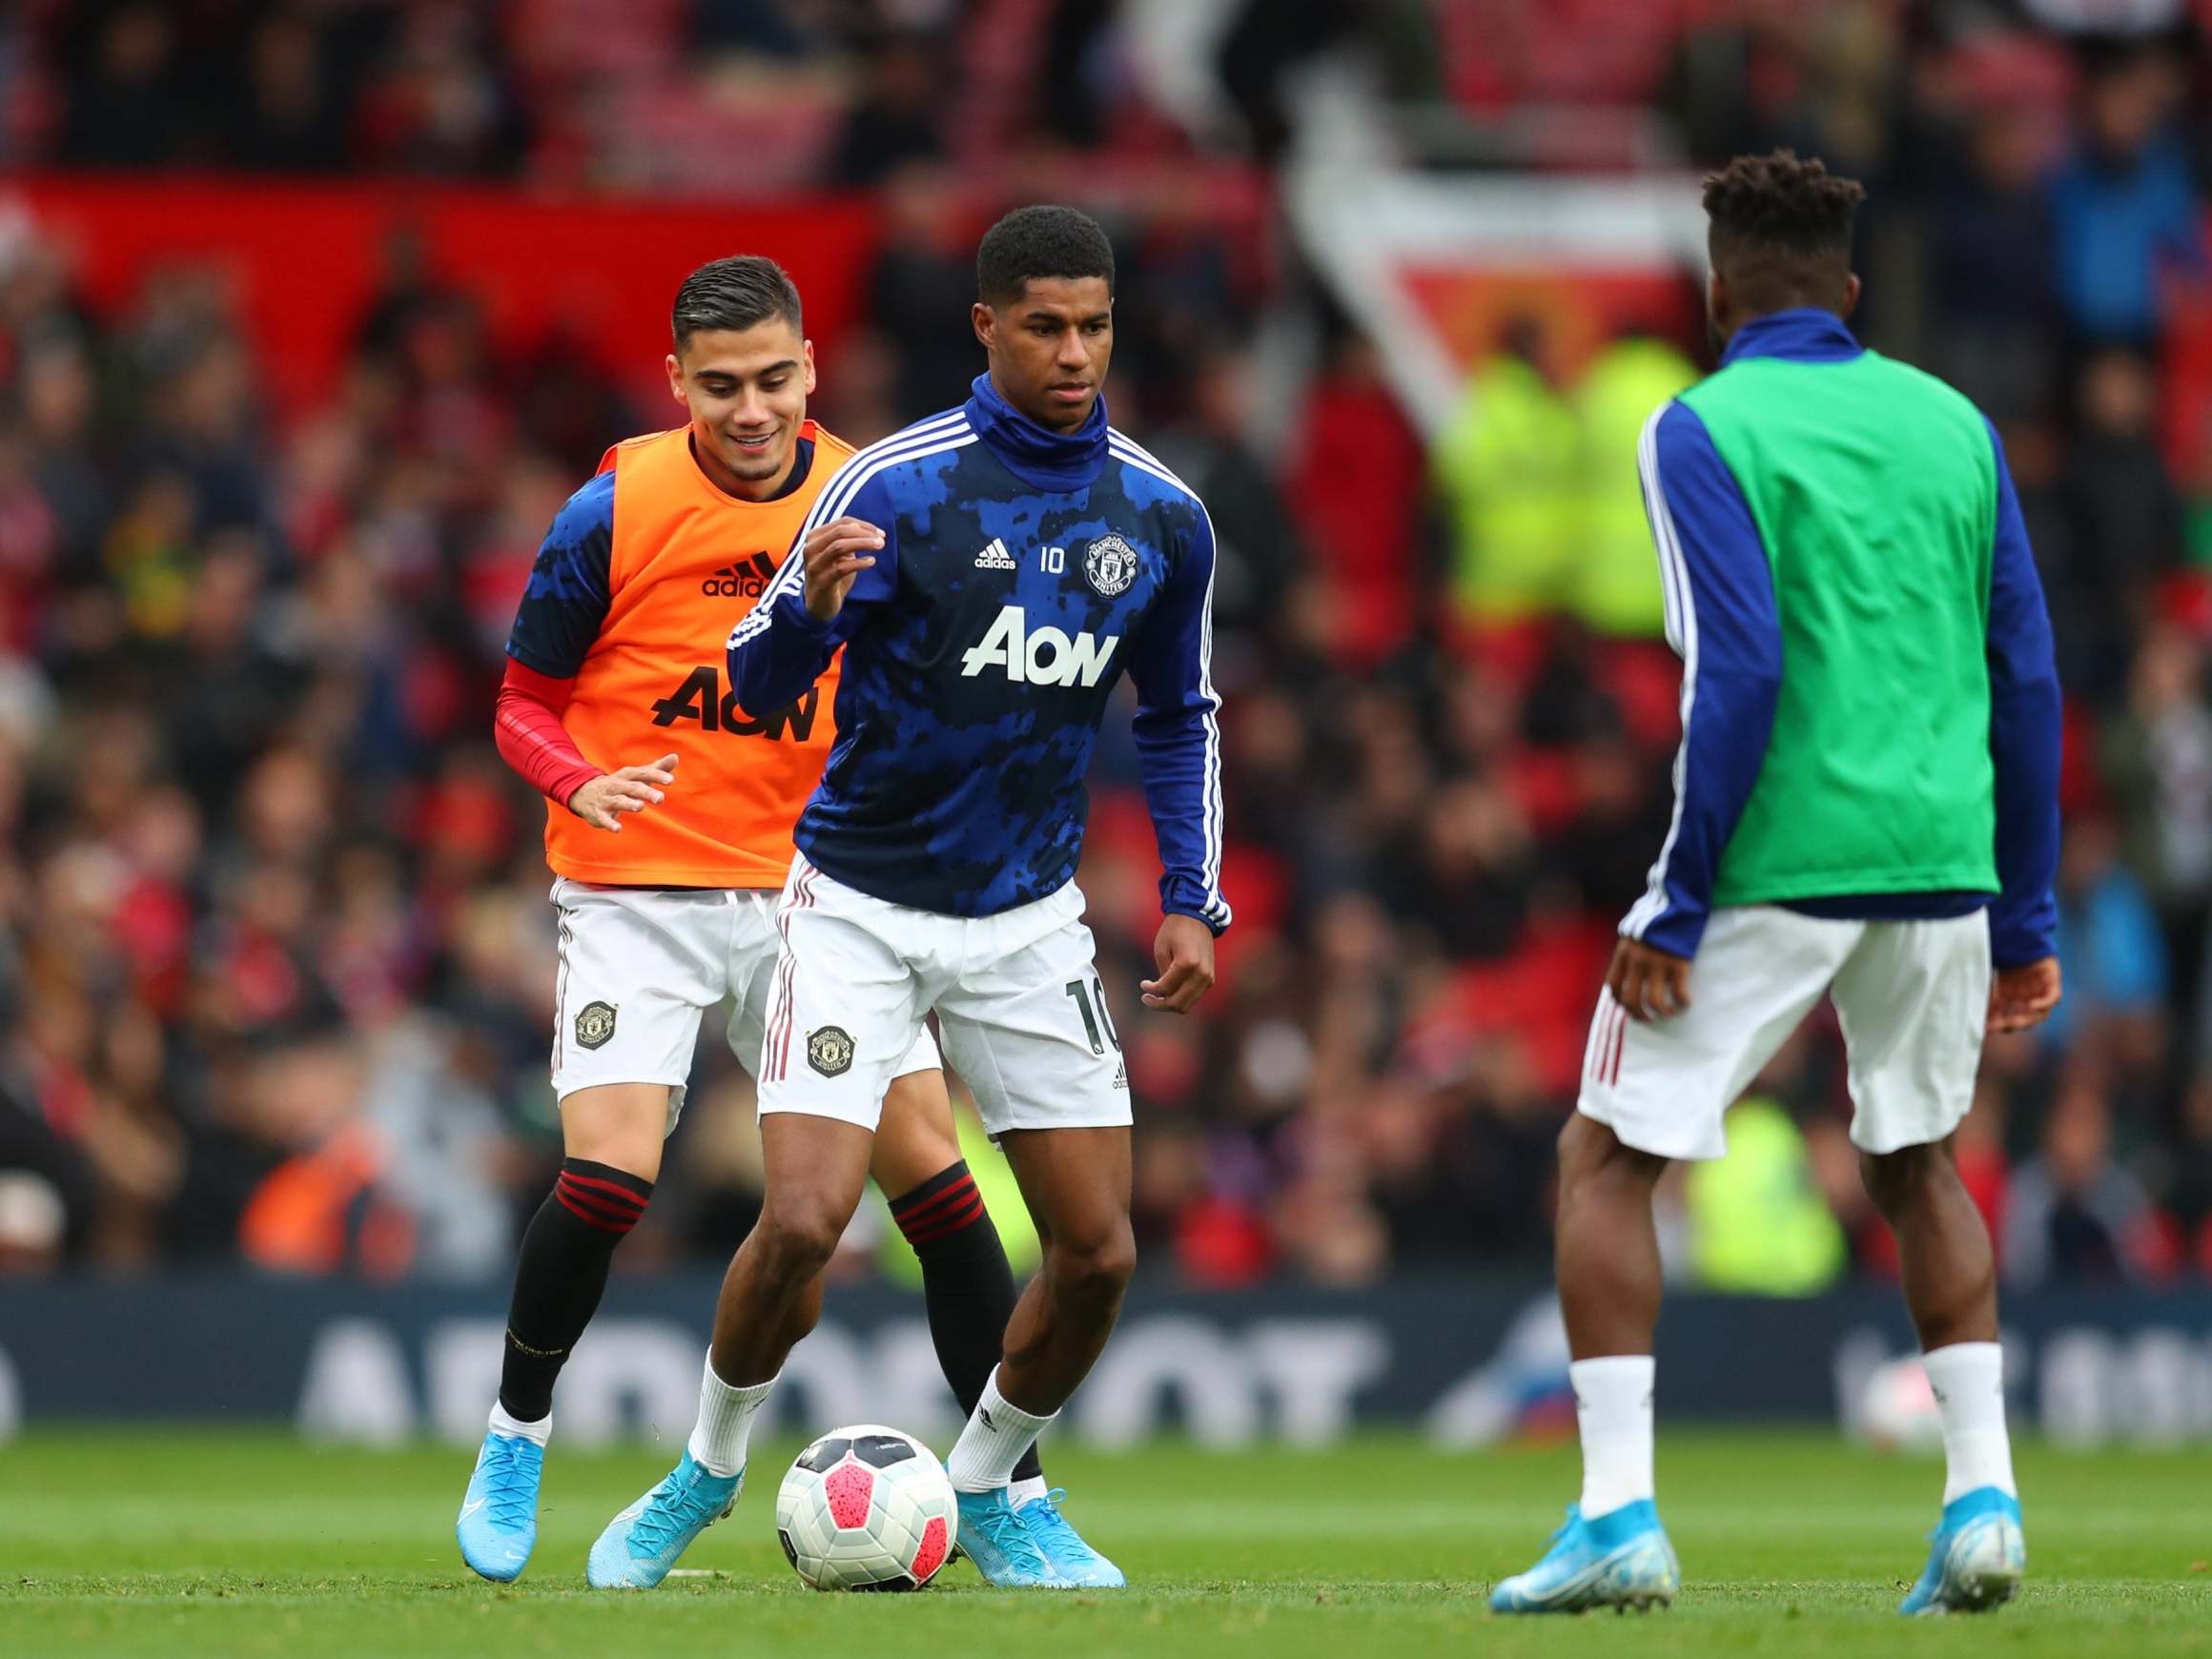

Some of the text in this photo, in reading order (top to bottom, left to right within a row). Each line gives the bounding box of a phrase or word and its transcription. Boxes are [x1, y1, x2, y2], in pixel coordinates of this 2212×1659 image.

[974, 546, 1065, 574] adidas 10
[1092, 540, 1135, 563] MANCHESTER
[702, 578, 769, 598] adid
[1096, 578, 1123, 591] UNITED
